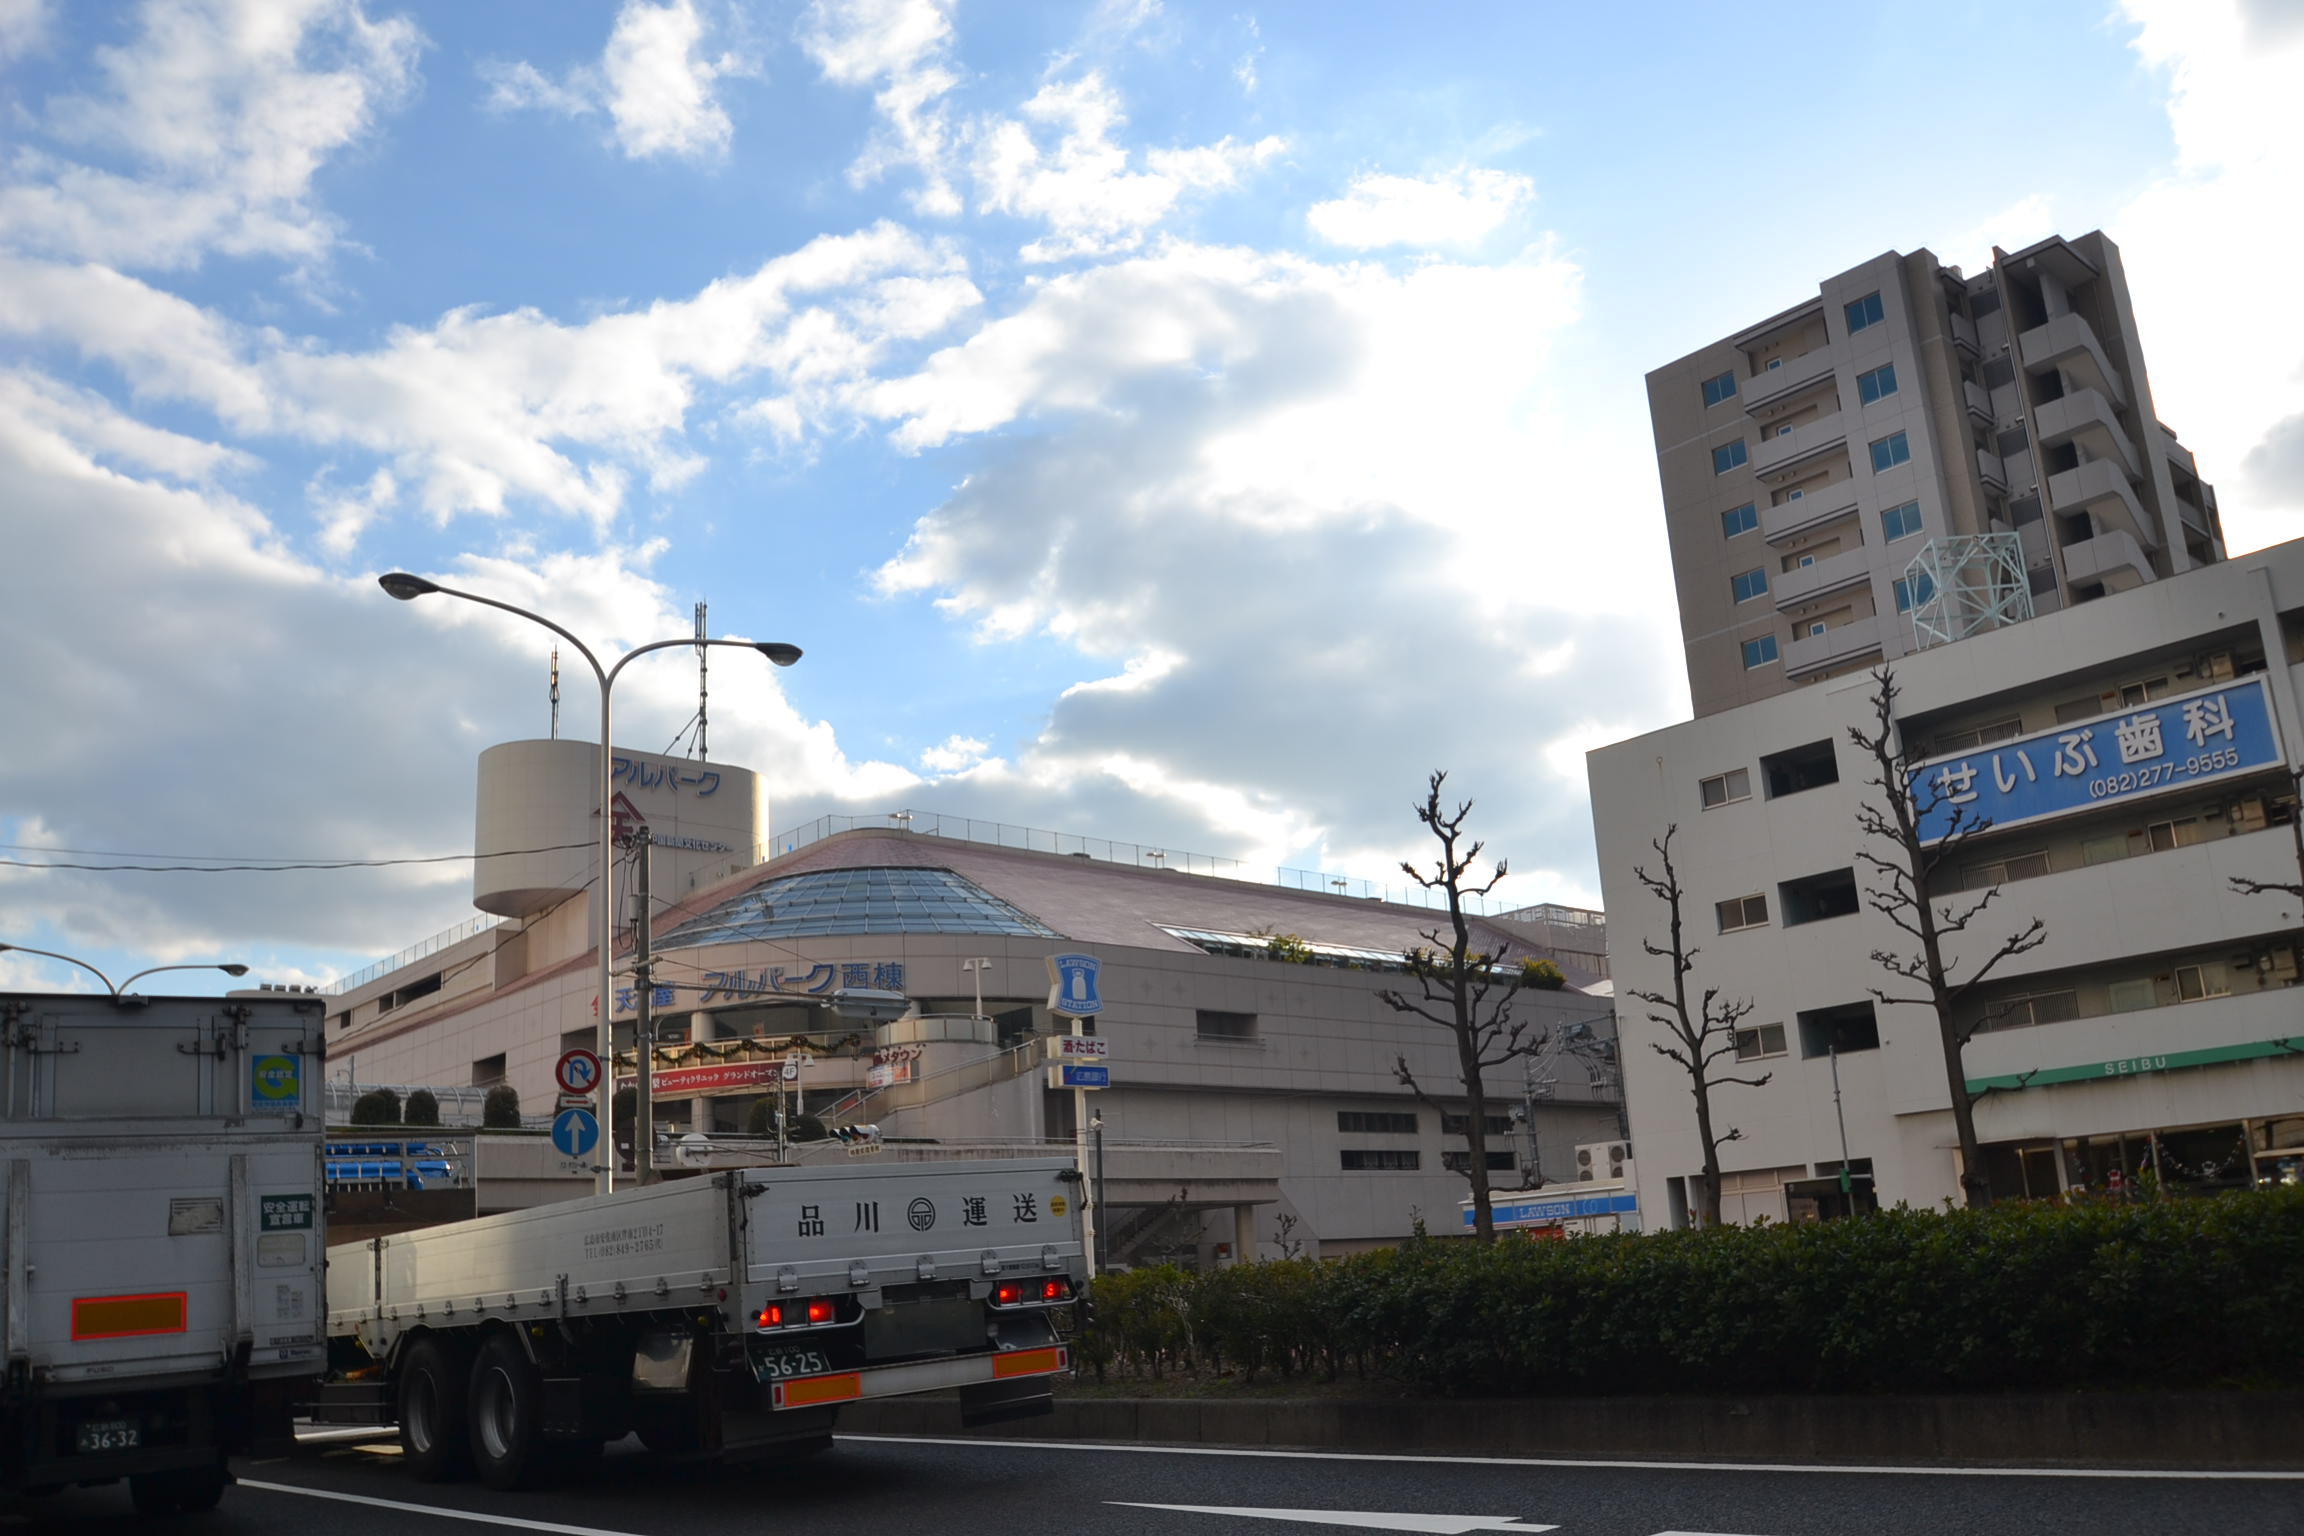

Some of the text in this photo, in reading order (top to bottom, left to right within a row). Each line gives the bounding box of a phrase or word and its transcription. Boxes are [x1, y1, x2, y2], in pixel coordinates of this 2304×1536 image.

[1937, 694, 2236, 804] せいぶ歯科
[611, 757, 720, 796] アルパーク
[2089, 747, 2239, 799] (082)277-9555
[615, 980, 674, 1013] 天屋
[2105, 1056, 2167, 1075] SEIBU
[798, 1192, 1038, 1237] 品川 運送
[1519, 1203, 1571, 1219] LAWSON
[764, 1352, 822, 1377] 56-25
[90, 1429, 138, 1449] 36-32
